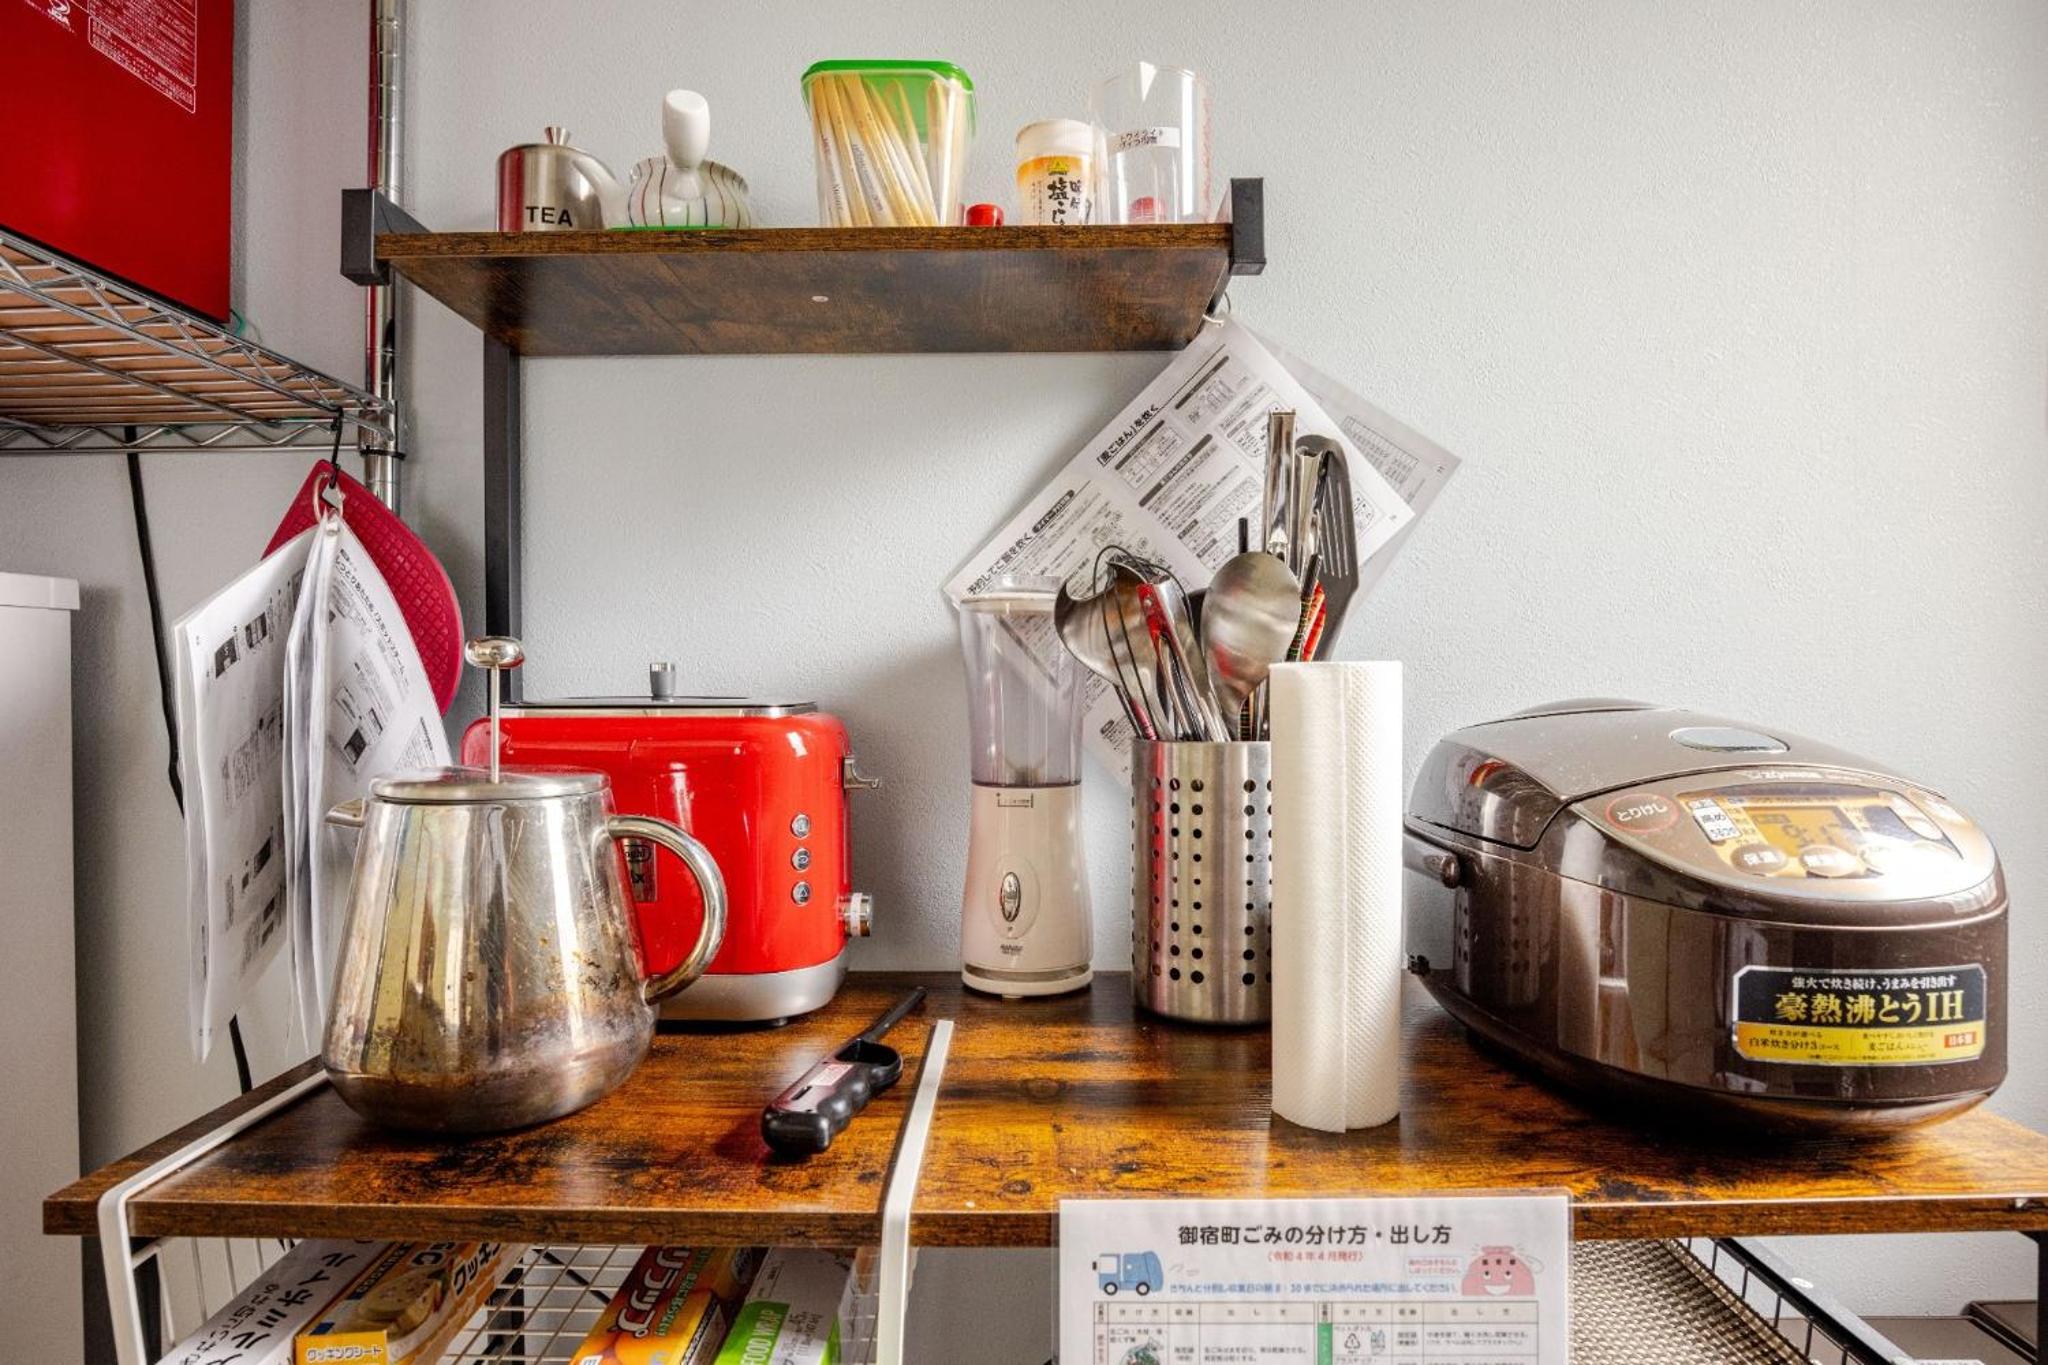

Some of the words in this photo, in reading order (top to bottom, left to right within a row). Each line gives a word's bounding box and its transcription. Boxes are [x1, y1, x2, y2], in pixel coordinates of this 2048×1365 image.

[525, 206, 574, 227] TEA
[1616, 801, 1670, 824] とりけし
[1791, 974, 1958, 991] 強火で炊き続け、うまみを引き出す
[1774, 989, 1965, 1025] 豪熱沸とうIH
[1947, 1033, 1975, 1048] 日本製
[1178, 1225, 1453, 1246] 御宿町ごみの分け方・出し方
[307, 1345, 382, 1361] クッキングシート
